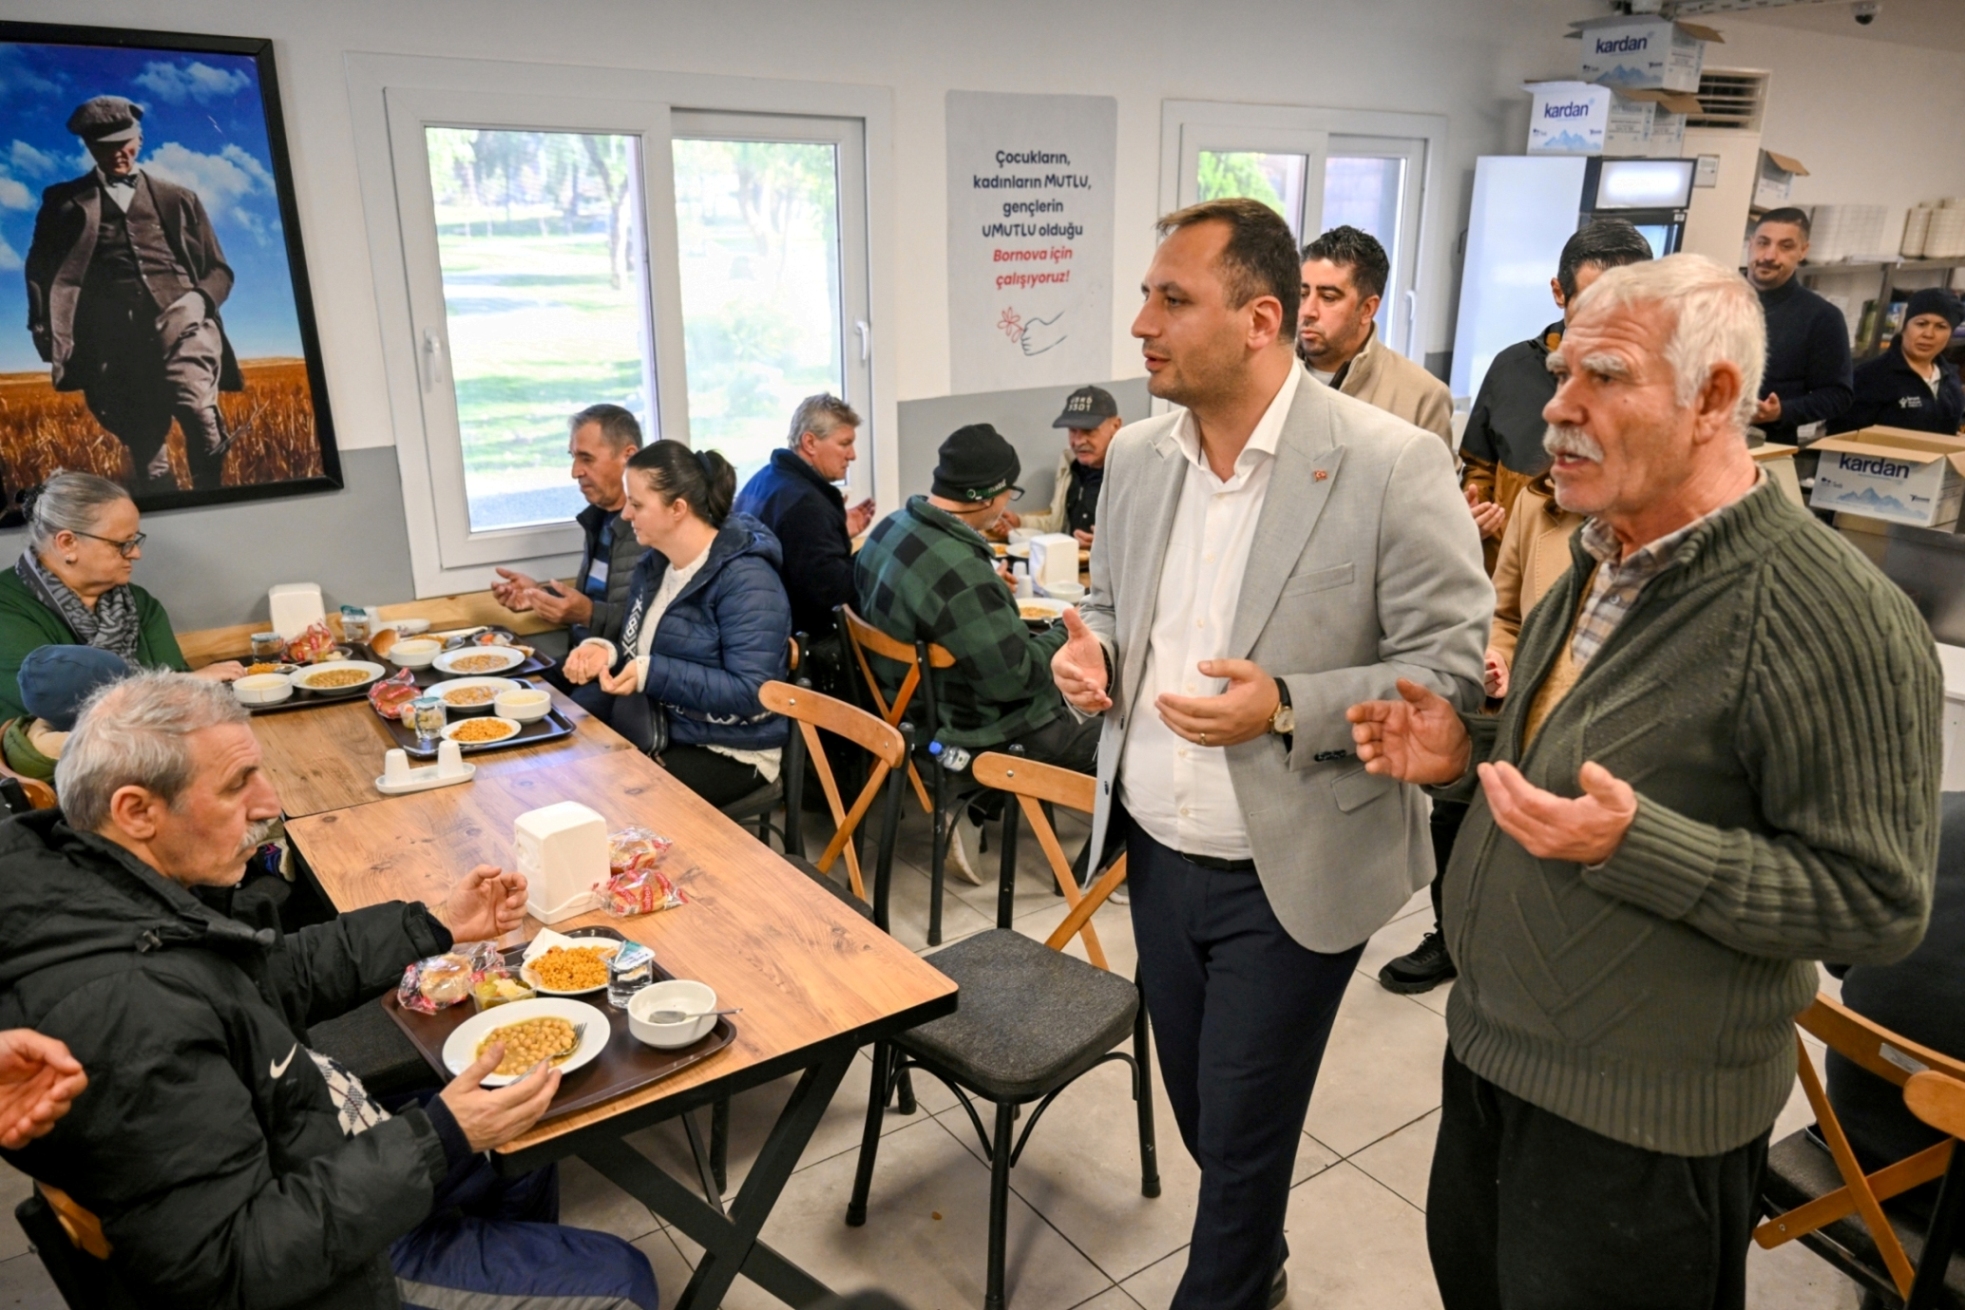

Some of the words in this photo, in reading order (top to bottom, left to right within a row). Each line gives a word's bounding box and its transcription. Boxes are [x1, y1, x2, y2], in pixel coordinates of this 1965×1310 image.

[1595, 35, 1648, 54] kardan
[1543, 101, 1589, 118] kardan
[995, 150, 1071, 168] Çocukların,
[973, 174, 1042, 189] kadınların
[1044, 175, 1092, 190] MUTLU,
[1002, 199, 1064, 217] gençlerin
[982, 223, 1037, 238] UMUTLU
[1038, 223, 1083, 240] olduğu
[993, 249, 1047, 262] Bornova
[1050, 247, 1073, 264] için
[995, 270, 1070, 290] çalışıyoruz!
[1838, 453, 1910, 479] kardan
